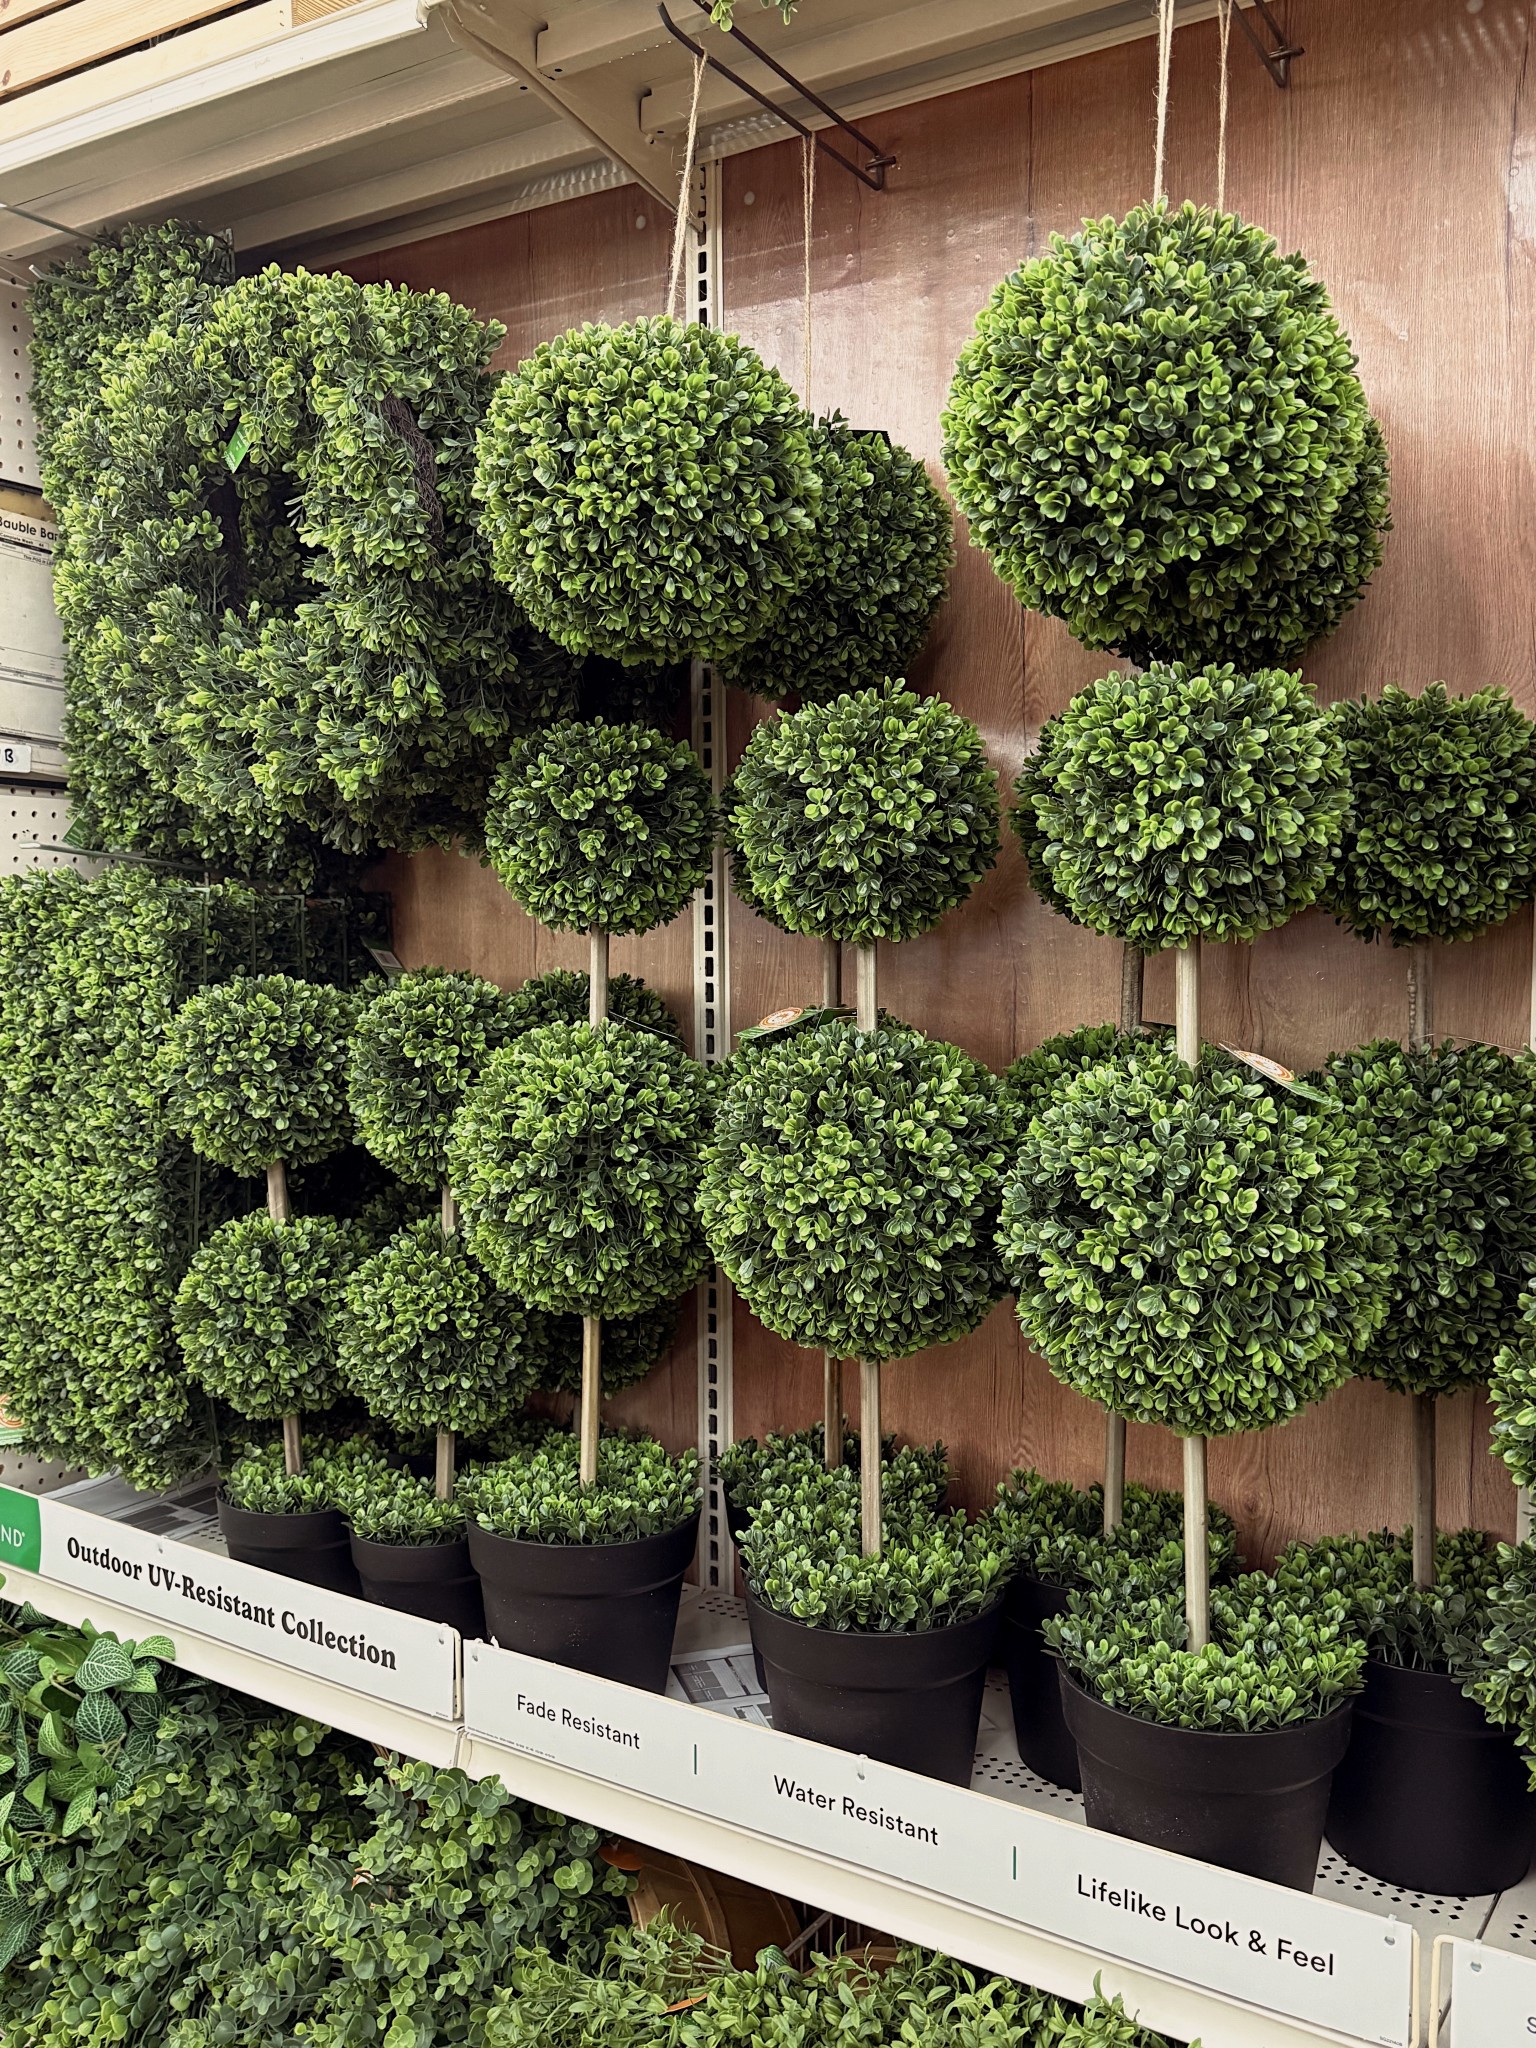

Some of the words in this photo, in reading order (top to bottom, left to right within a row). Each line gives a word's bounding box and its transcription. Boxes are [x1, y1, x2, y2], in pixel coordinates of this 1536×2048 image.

[67, 1536, 143, 1581] Outdoor
[147, 1563, 276, 1629] UV-Resistant
[281, 1610, 397, 1671] Collection
[517, 1693, 556, 1722] Fade
[562, 1708, 640, 1750] Resistant
[773, 1774, 836, 1811] Water
[842, 1796, 938, 1846] Resistant
[1077, 1873, 1166, 1922] Lifelike
[1176, 1905, 1239, 1947] Look
[1248, 1929, 1267, 1956] &
[1277, 1937, 1334, 1976] Feel
